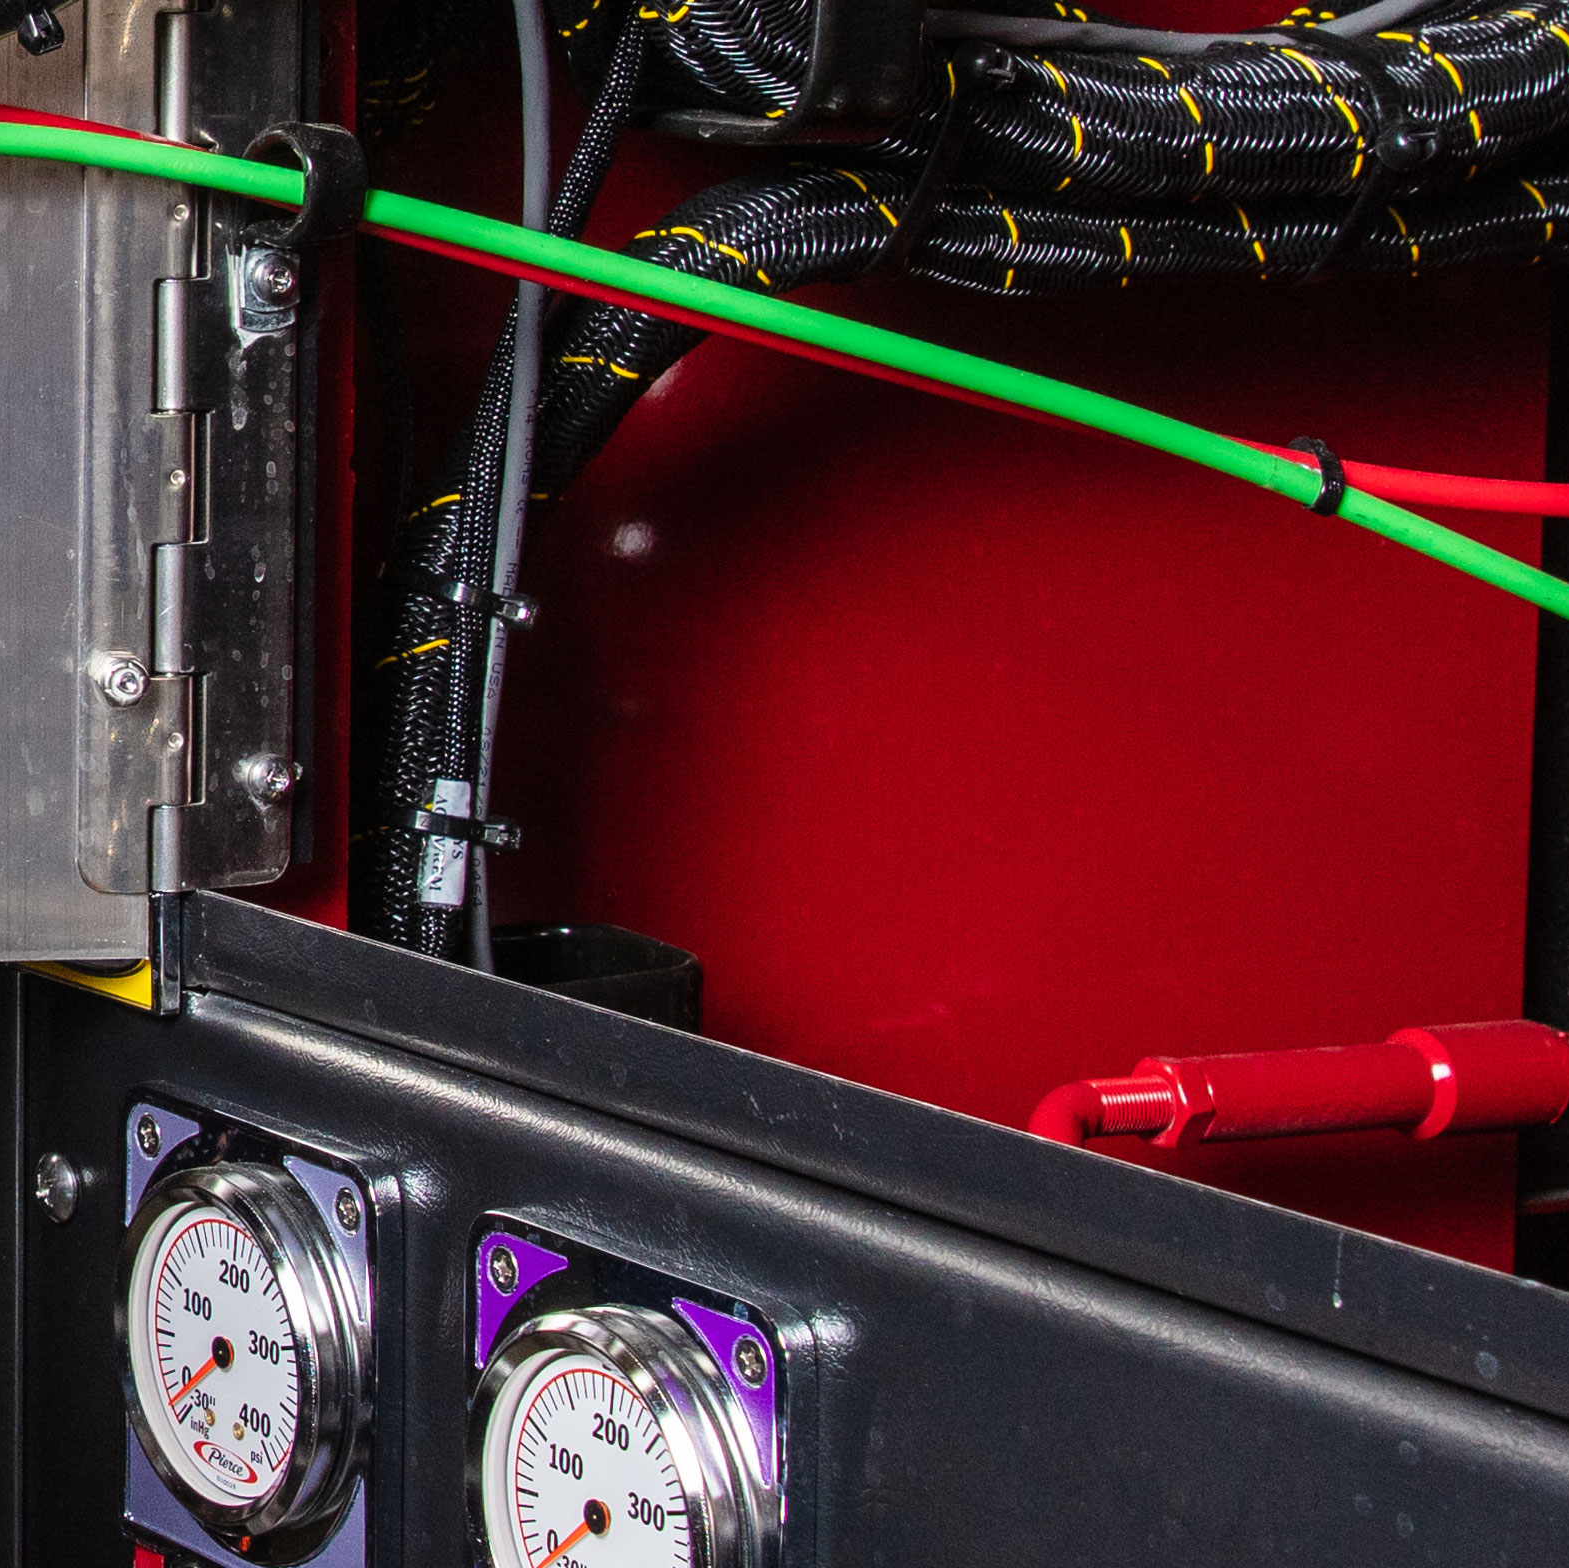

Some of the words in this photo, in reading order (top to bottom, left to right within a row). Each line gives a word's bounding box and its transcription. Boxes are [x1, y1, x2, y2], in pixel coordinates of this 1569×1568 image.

[219, 1259, 250, 1294] 200
[183, 1288, 212, 1321] 100
[248, 1330, 281, 1366] 300
[190, 1415, 211, 1440] inHg
[239, 1402, 271, 1438] 400
[592, 1412, 630, 1451] 200
[207, 1446, 244, 1477] Pierce
[250, 1443, 264, 1465] psi
[549, 1443, 583, 1480] 100
[627, 1492, 665, 1532] 300
[547, 1529, 559, 1554] 0
